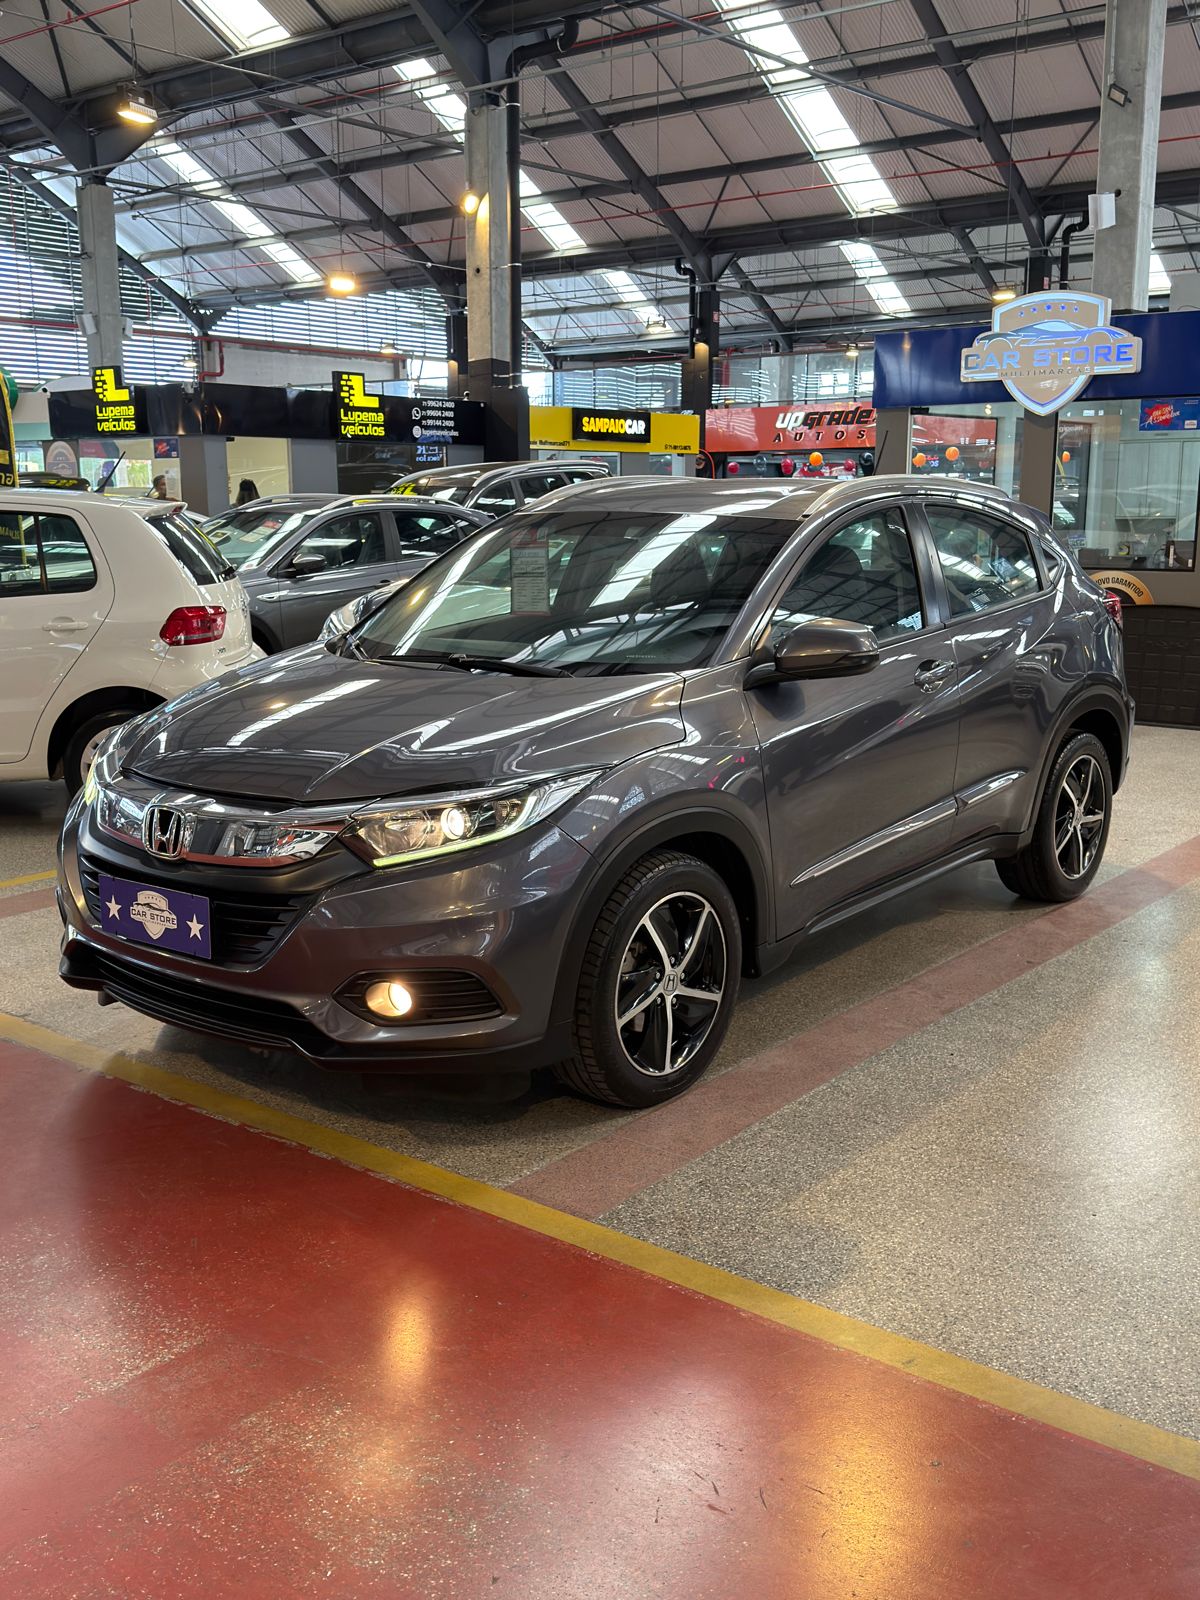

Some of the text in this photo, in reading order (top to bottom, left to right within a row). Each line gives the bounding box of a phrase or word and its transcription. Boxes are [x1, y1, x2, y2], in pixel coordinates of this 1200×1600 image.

[963, 344, 1133, 371] CAR STORE
[96, 405, 135, 417] Lupema
[340, 409, 385, 423] Lupema
[97, 418, 136, 432] veículos
[341, 423, 385, 437] veículos
[582, 416, 646, 435] SAMPAIOCAR
[773, 429, 867, 443] AUTOS
[1111, 577, 1143, 597] GARANTIDO
[131, 908, 177, 926] CAR STORE
